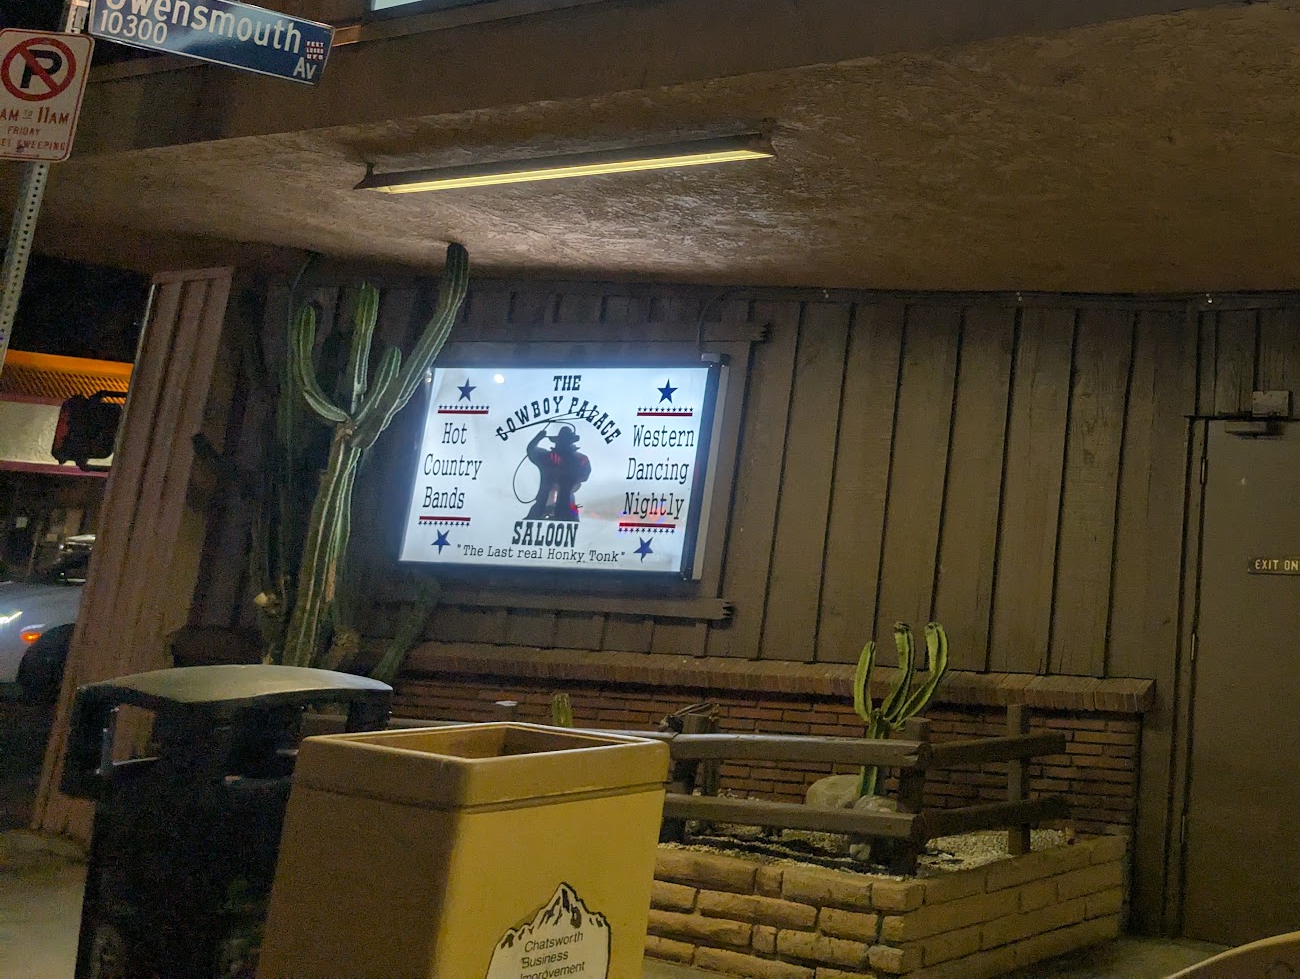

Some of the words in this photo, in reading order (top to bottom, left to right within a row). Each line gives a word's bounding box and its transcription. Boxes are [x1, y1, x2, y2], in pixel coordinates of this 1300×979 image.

[100, 9, 167, 45] 10300
[7, 126, 41, 135] FRIDAY
[553, 375, 582, 391] THE
[497, 396, 564, 442] COWBOY
[568, 397, 622, 444] PALACE
[442, 423, 467, 444] Hot
[633, 424, 694, 447] Western
[424, 453, 482, 480] Country
[626, 458, 689, 485] Dancing
[422, 487, 465, 509] Bands
[623, 492, 685, 520] Nightly
[512, 521, 579, 547] SALOON
[487, 545, 514, 559] Last
[517, 547, 543, 560] real
[547, 549, 585, 562] Honky
[1255, 559, 1279, 570] EXIT
[524, 931, 583, 953] Chatsworth
[521, 951, 568, 969] Business
